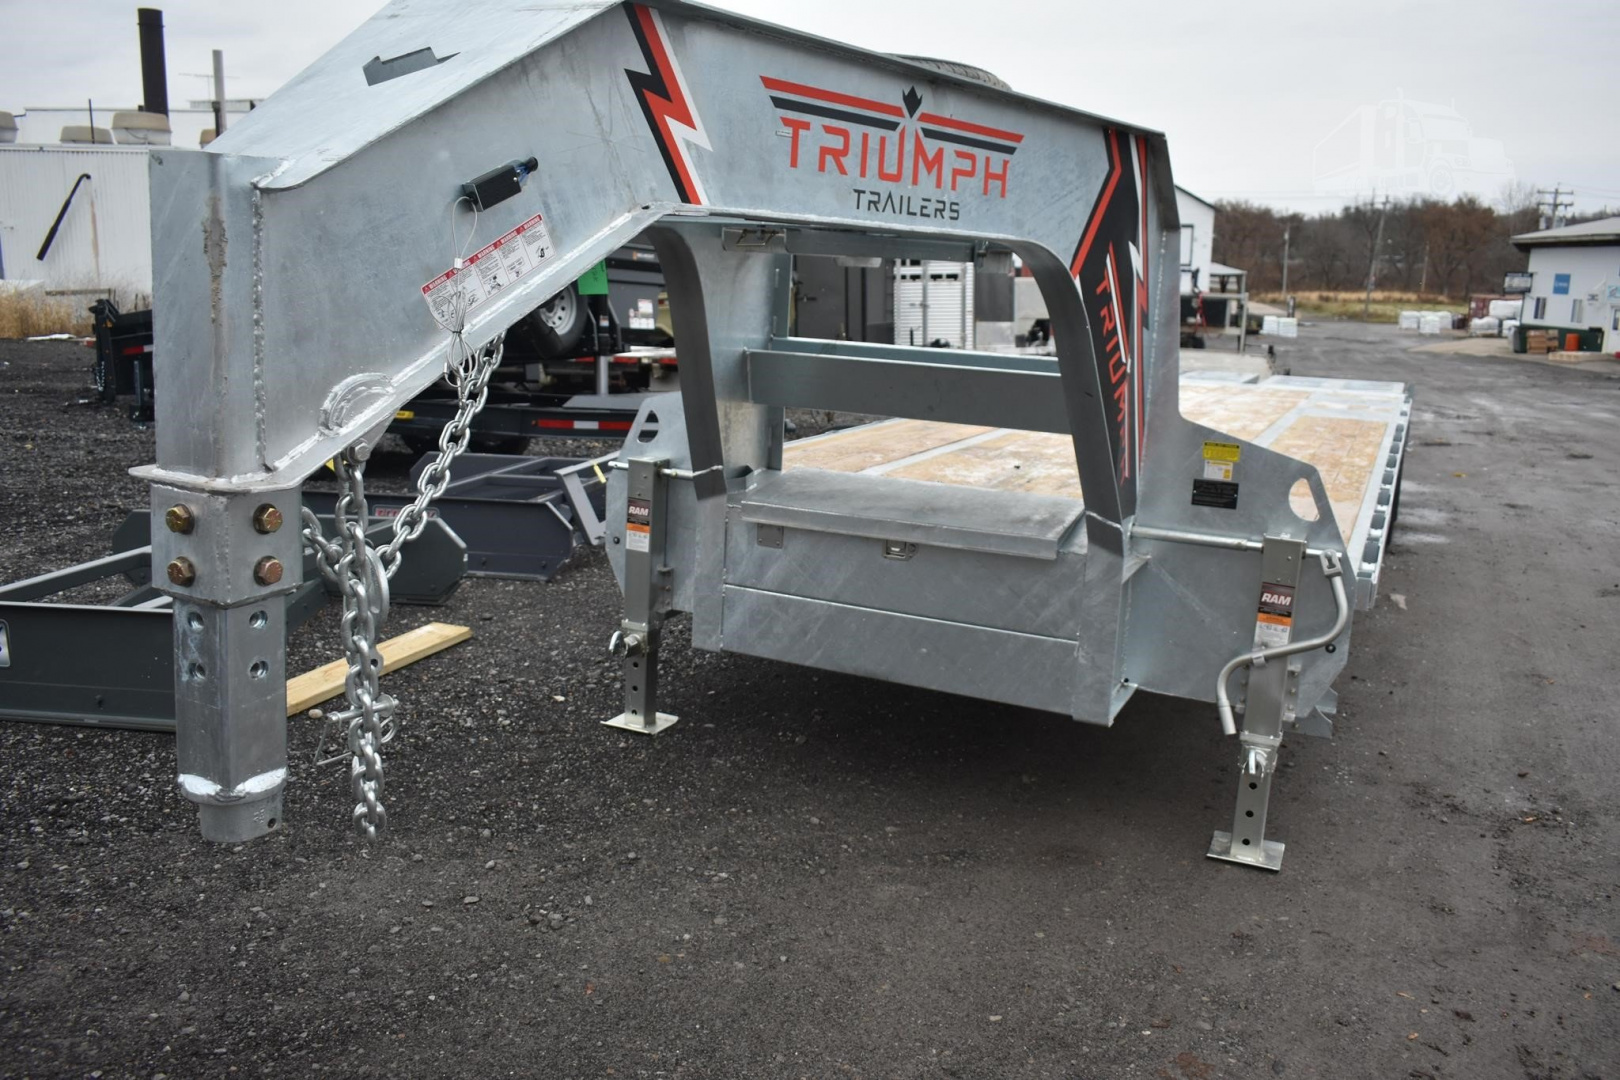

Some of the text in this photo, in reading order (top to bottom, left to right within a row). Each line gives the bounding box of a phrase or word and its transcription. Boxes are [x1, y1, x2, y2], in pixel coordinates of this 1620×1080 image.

[780, 117, 1010, 199] TRIUMPH
[852, 188, 960, 221] TRAILERS
[628, 506, 649, 517] RAM
[1261, 592, 1292, 606] RAM
